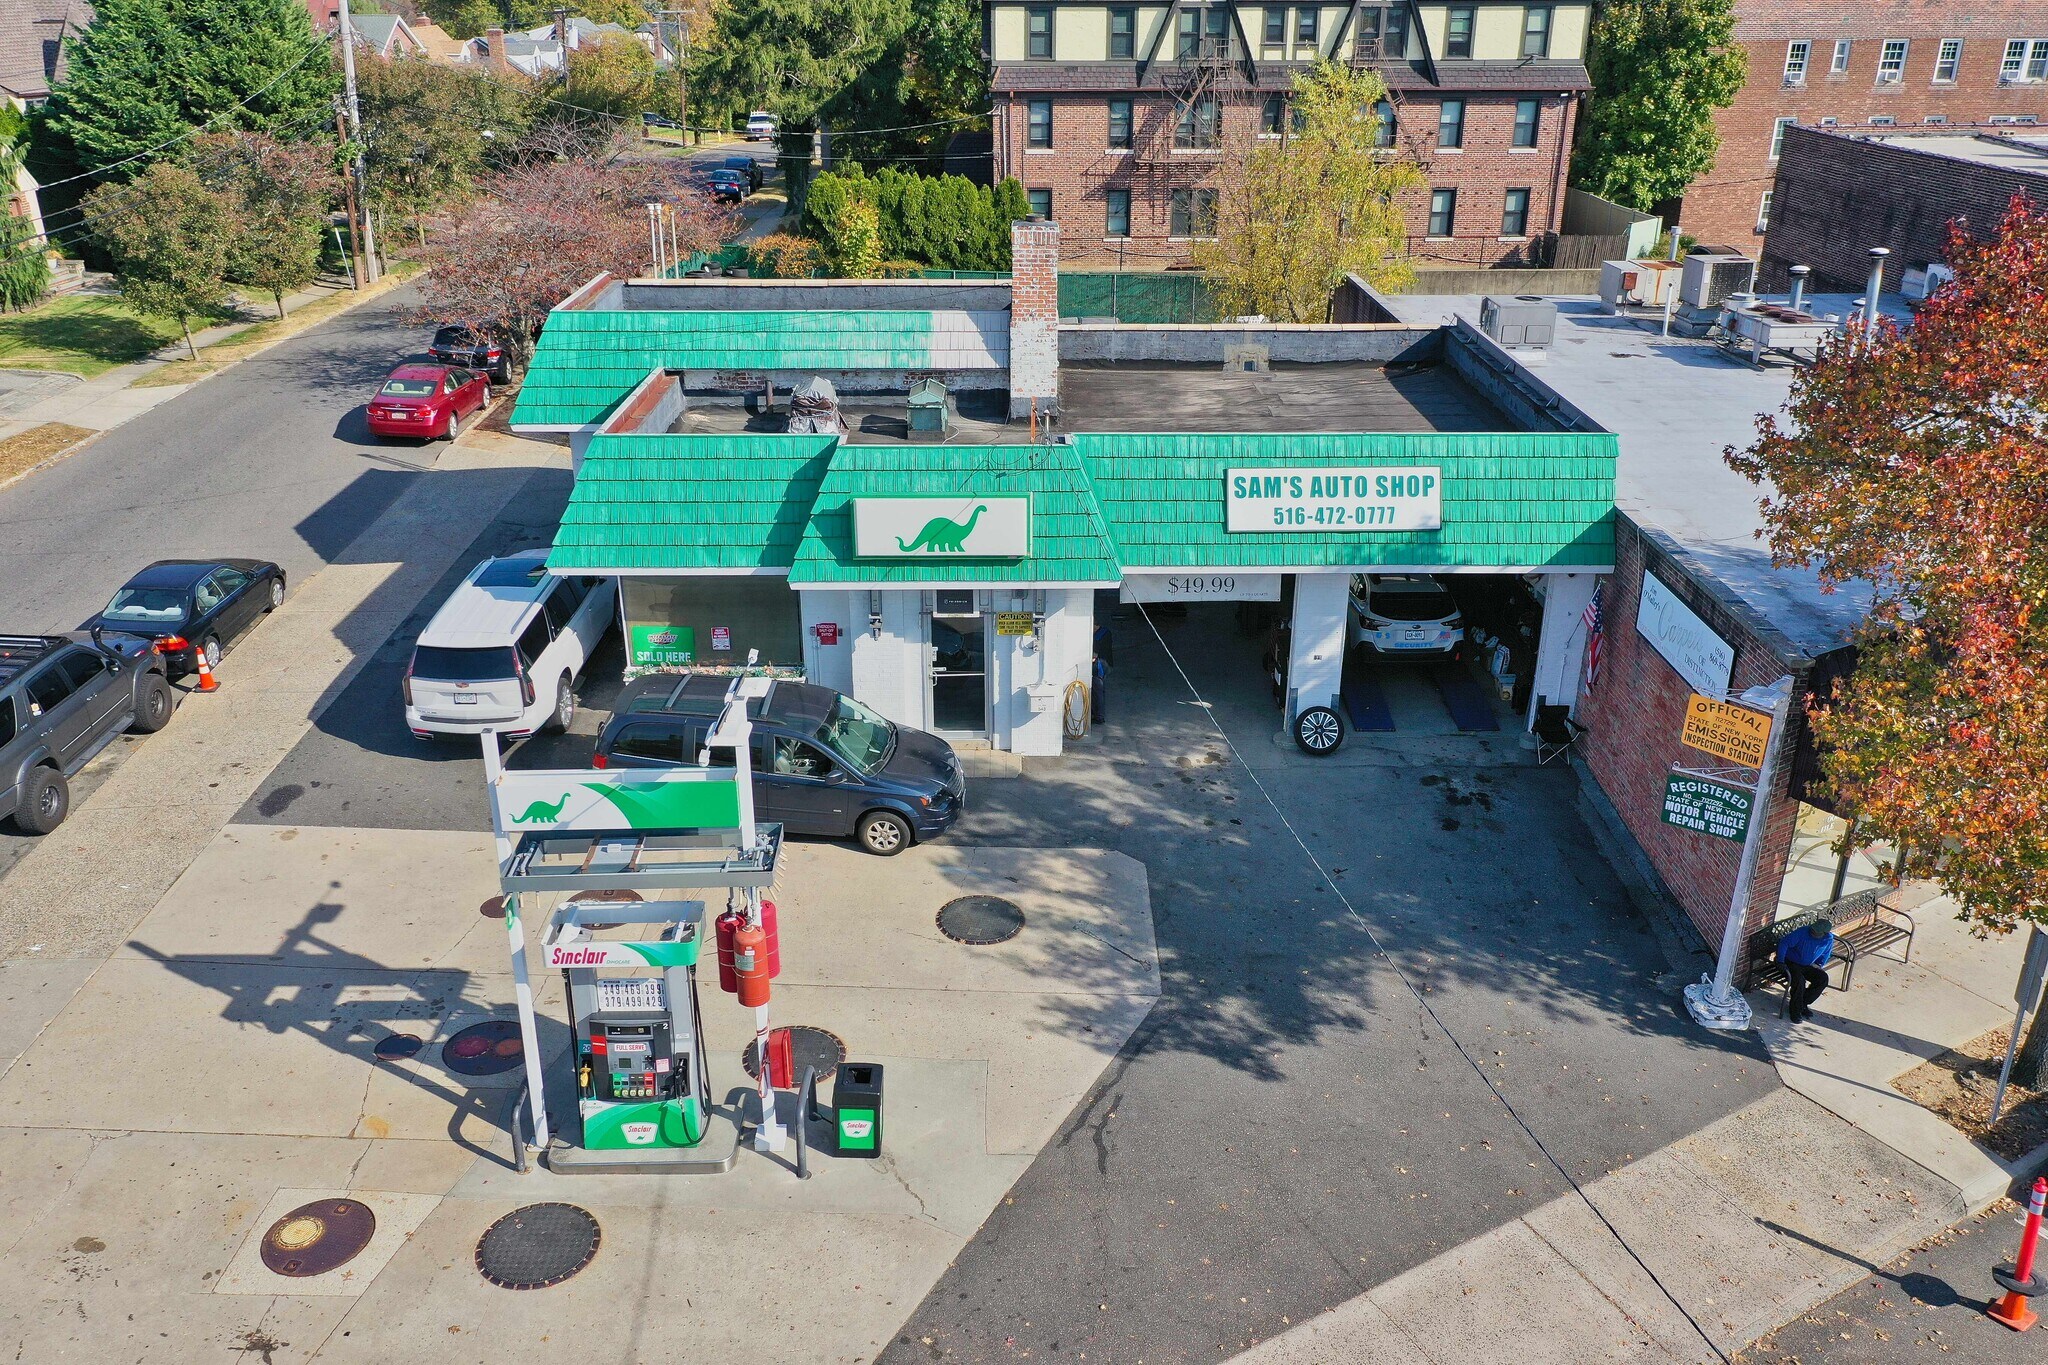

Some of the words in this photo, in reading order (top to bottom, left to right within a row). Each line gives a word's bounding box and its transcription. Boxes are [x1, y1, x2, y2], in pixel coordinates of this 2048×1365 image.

[1234, 476, 1302, 499] SAM'S
[1310, 475, 1368, 498] AUTO
[1376, 475, 1435, 498] SHOP
[1273, 506, 1396, 526] 516-472-0777
[1168, 576, 1236, 596] $49.99
[636, 651, 663, 662] SOLD
[666, 652, 692, 662] HERE
[1698, 654, 1706, 666] OF
[1684, 654, 1716, 692] DISTINCTION
[1688, 715, 1710, 726] STATE
[1725, 727, 1741, 736] NEW
[1744, 733, 1764, 744] YORK
[1696, 702, 1762, 732] OFFICIAL
[1684, 732, 1726, 754] INSPECTION
[1728, 747, 1759, 765] STATION
[1687, 722, 1761, 753] EMISSIONS
[1666, 794, 1690, 804] STATE
[1705, 804, 1723, 813] NEW
[1725, 809, 1746, 819] YORK
[1670, 782, 1748, 809] REGISTERED
[1665, 800, 1700, 818] MOTOR
[1704, 810, 1745, 830] VEHICLE
[1668, 813, 1705, 830] REPAIR
[1709, 824, 1737, 838] SHOP
[552, 947, 608, 965] Sinclair
[604, 984, 620, 995] 349
[625, 984, 641, 995] 469
[645, 984, 661, 995] 399
[605, 997, 622, 1007] 379
[626, 996, 642, 1007] 499
[646, 997, 662, 1007] 429
